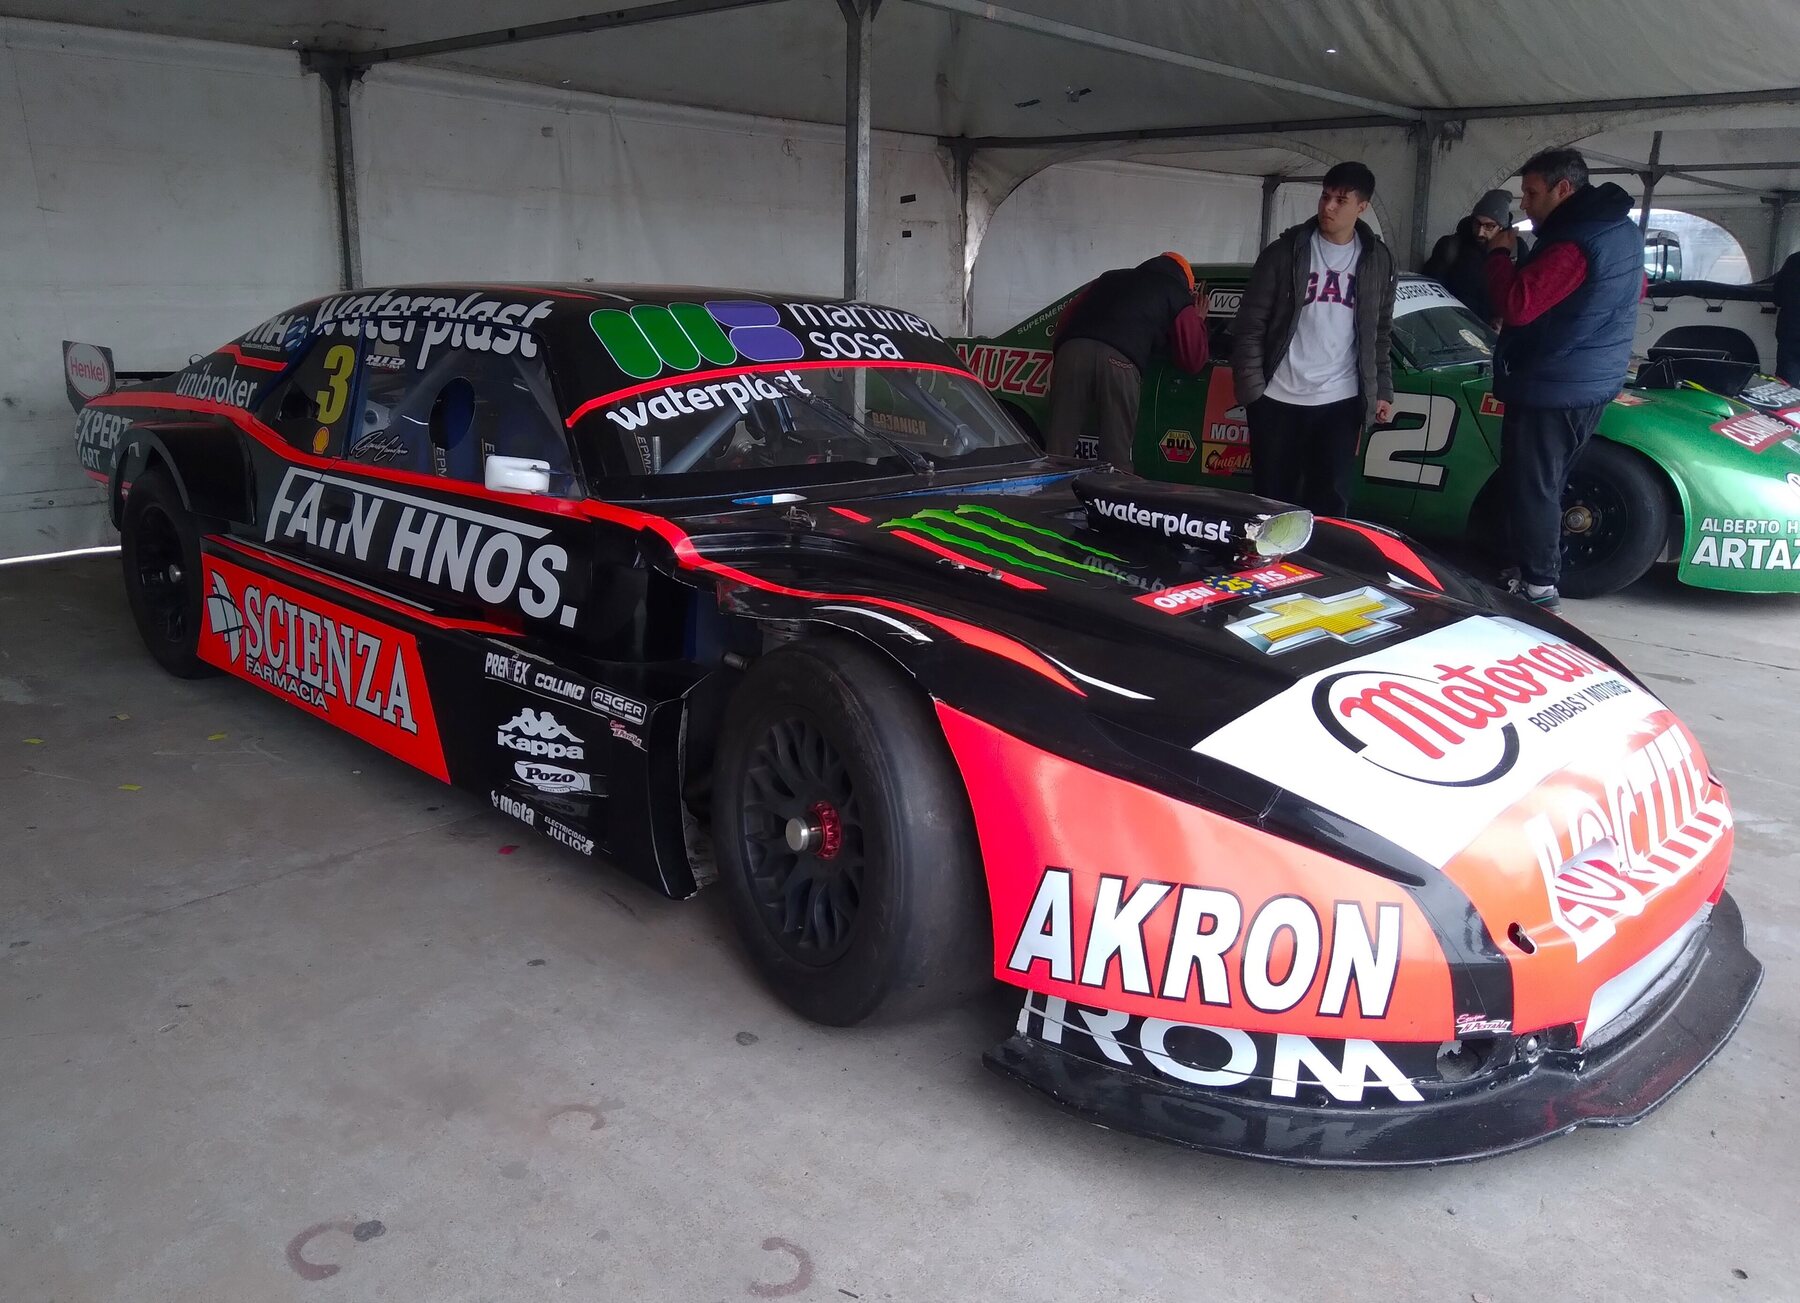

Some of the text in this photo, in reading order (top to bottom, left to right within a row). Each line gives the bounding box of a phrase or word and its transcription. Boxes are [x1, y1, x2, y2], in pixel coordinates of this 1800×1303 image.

[782, 302, 946, 344] martinez
[1213, 294, 1243, 309] WO
[310, 288, 556, 370] waterplast
[808, 331, 904, 360] sosa
[69, 356, 106, 383] Henkel
[176, 362, 258, 408] unibroker
[315, 344, 356, 424] 3
[956, 344, 1055, 397] MUZZ
[605, 369, 812, 431] waterplast
[1210, 423, 1250, 441] MOT
[1363, 392, 1457, 491] 2
[1093, 498, 1232, 543] waterplast
[1700, 518, 1780, 534] ALBERTO
[387, 505, 578, 629] HNOS.
[1154, 586, 1217, 609] OPEN
[1218, 571, 1253, 592] 25
[244, 585, 418, 734] SCIENZA
[245, 655, 330, 712] FARMACIA
[535, 672, 586, 701] COLLINO
[1528, 679, 1632, 733] BOMBAS Y MOTORES
[497, 731, 585, 760] Kappa
[544, 815, 586, 842] ELECTRICIDAD
[1006, 866, 1403, 1020] AKRON
